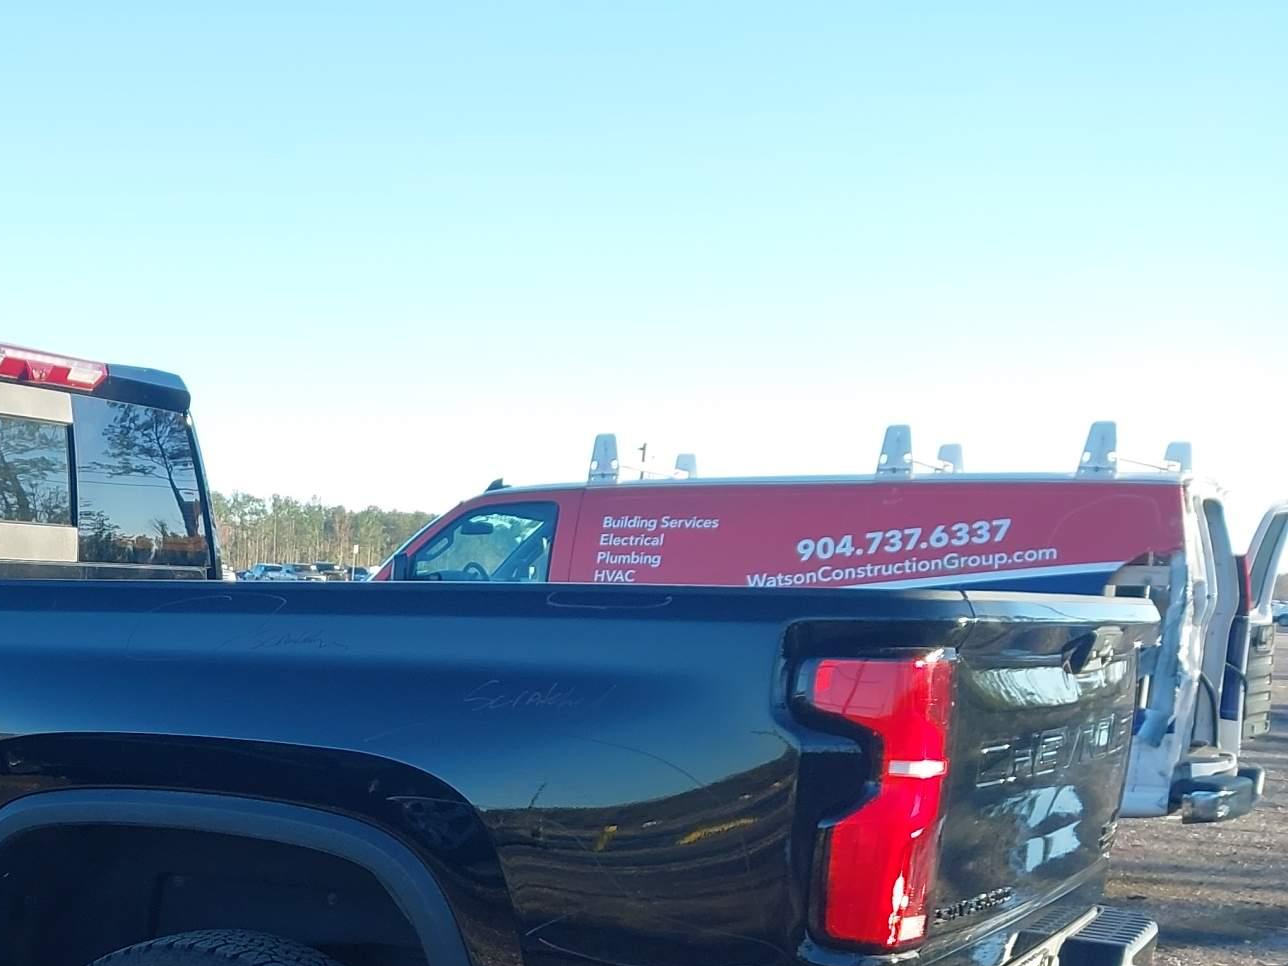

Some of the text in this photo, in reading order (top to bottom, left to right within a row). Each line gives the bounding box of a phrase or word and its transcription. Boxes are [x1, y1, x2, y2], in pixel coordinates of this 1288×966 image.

[602, 515, 720, 531] Building Services
[599, 533, 665, 546] Electrical
[796, 518, 1012, 562] 904.737.6337
[597, 551, 662, 567] Plumbing
[594, 569, 636, 582] HVAC
[745, 547, 1058, 588] WatsonConstructionGroup.com
